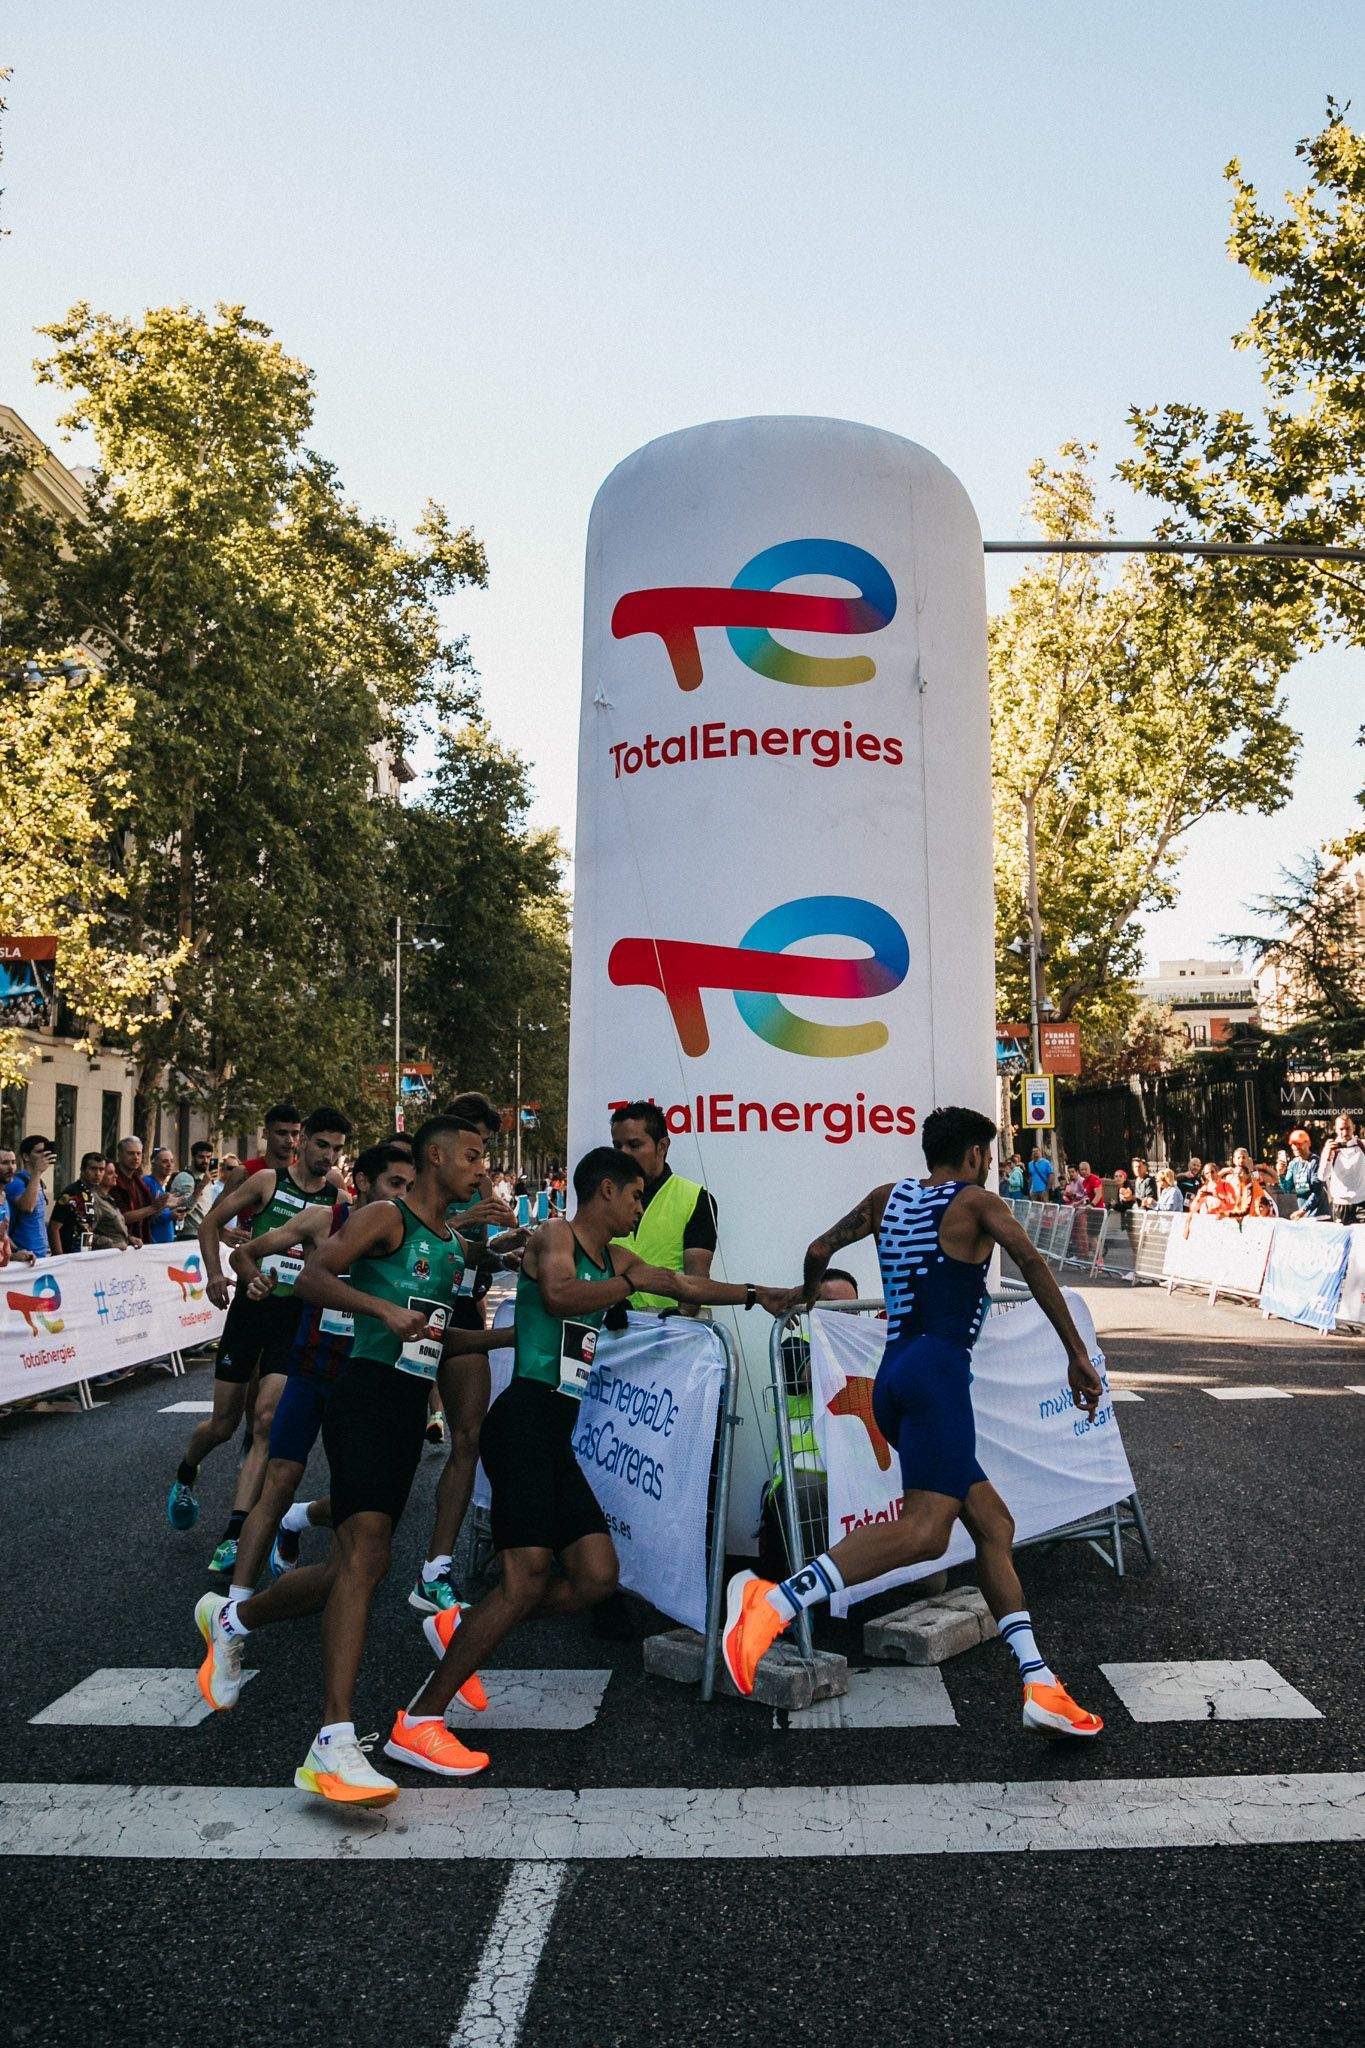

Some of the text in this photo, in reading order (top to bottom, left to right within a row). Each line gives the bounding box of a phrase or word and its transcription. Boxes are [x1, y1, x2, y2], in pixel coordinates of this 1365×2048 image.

[609, 720, 903, 778] TotalEnergies
[1280, 1086, 1333, 1102] MAN
[607, 1092, 916, 1145] alEnergies
[1281, 1108, 1307, 1116] MUSEO
[19, 1344, 77, 1370] TotalEnergies
